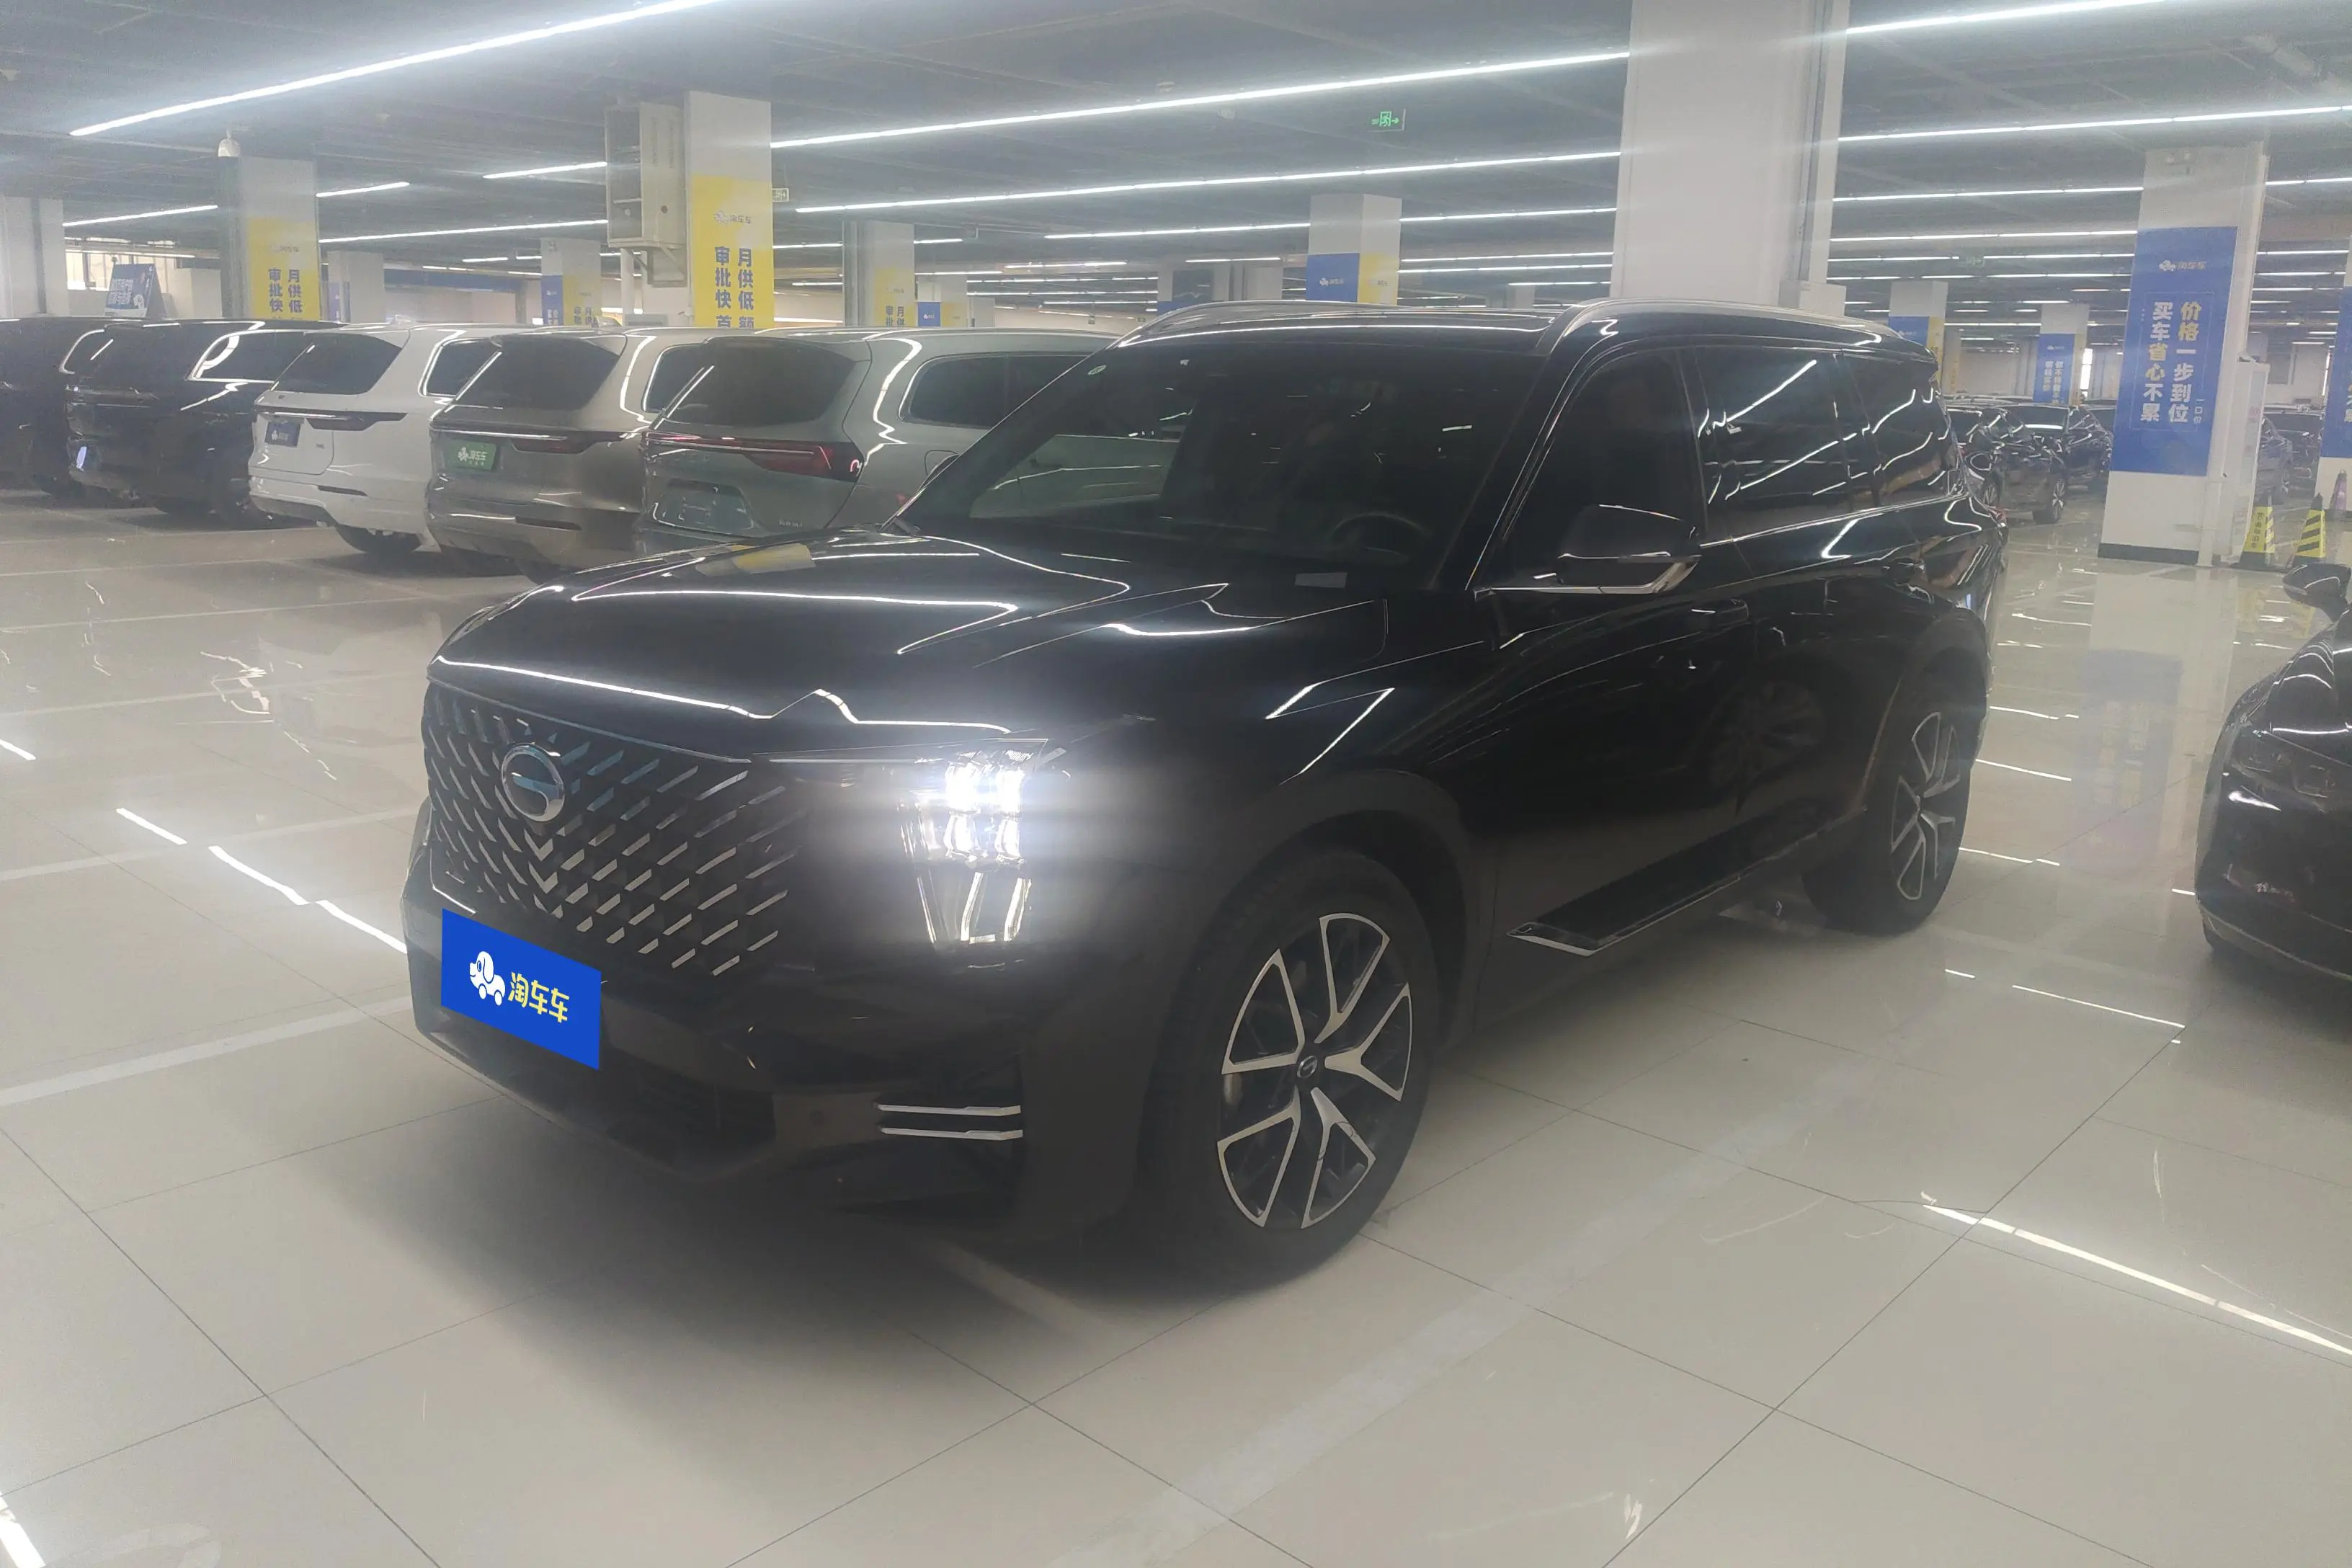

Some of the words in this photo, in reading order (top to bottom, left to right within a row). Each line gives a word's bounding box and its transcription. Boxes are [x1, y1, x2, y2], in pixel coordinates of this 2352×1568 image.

[268, 267, 283, 319] 审批快
[288, 269, 303, 319] 月供低
[2140, 301, 2174, 422] 买车省心不累
[2168, 301, 2202, 424] 价格一步到位
